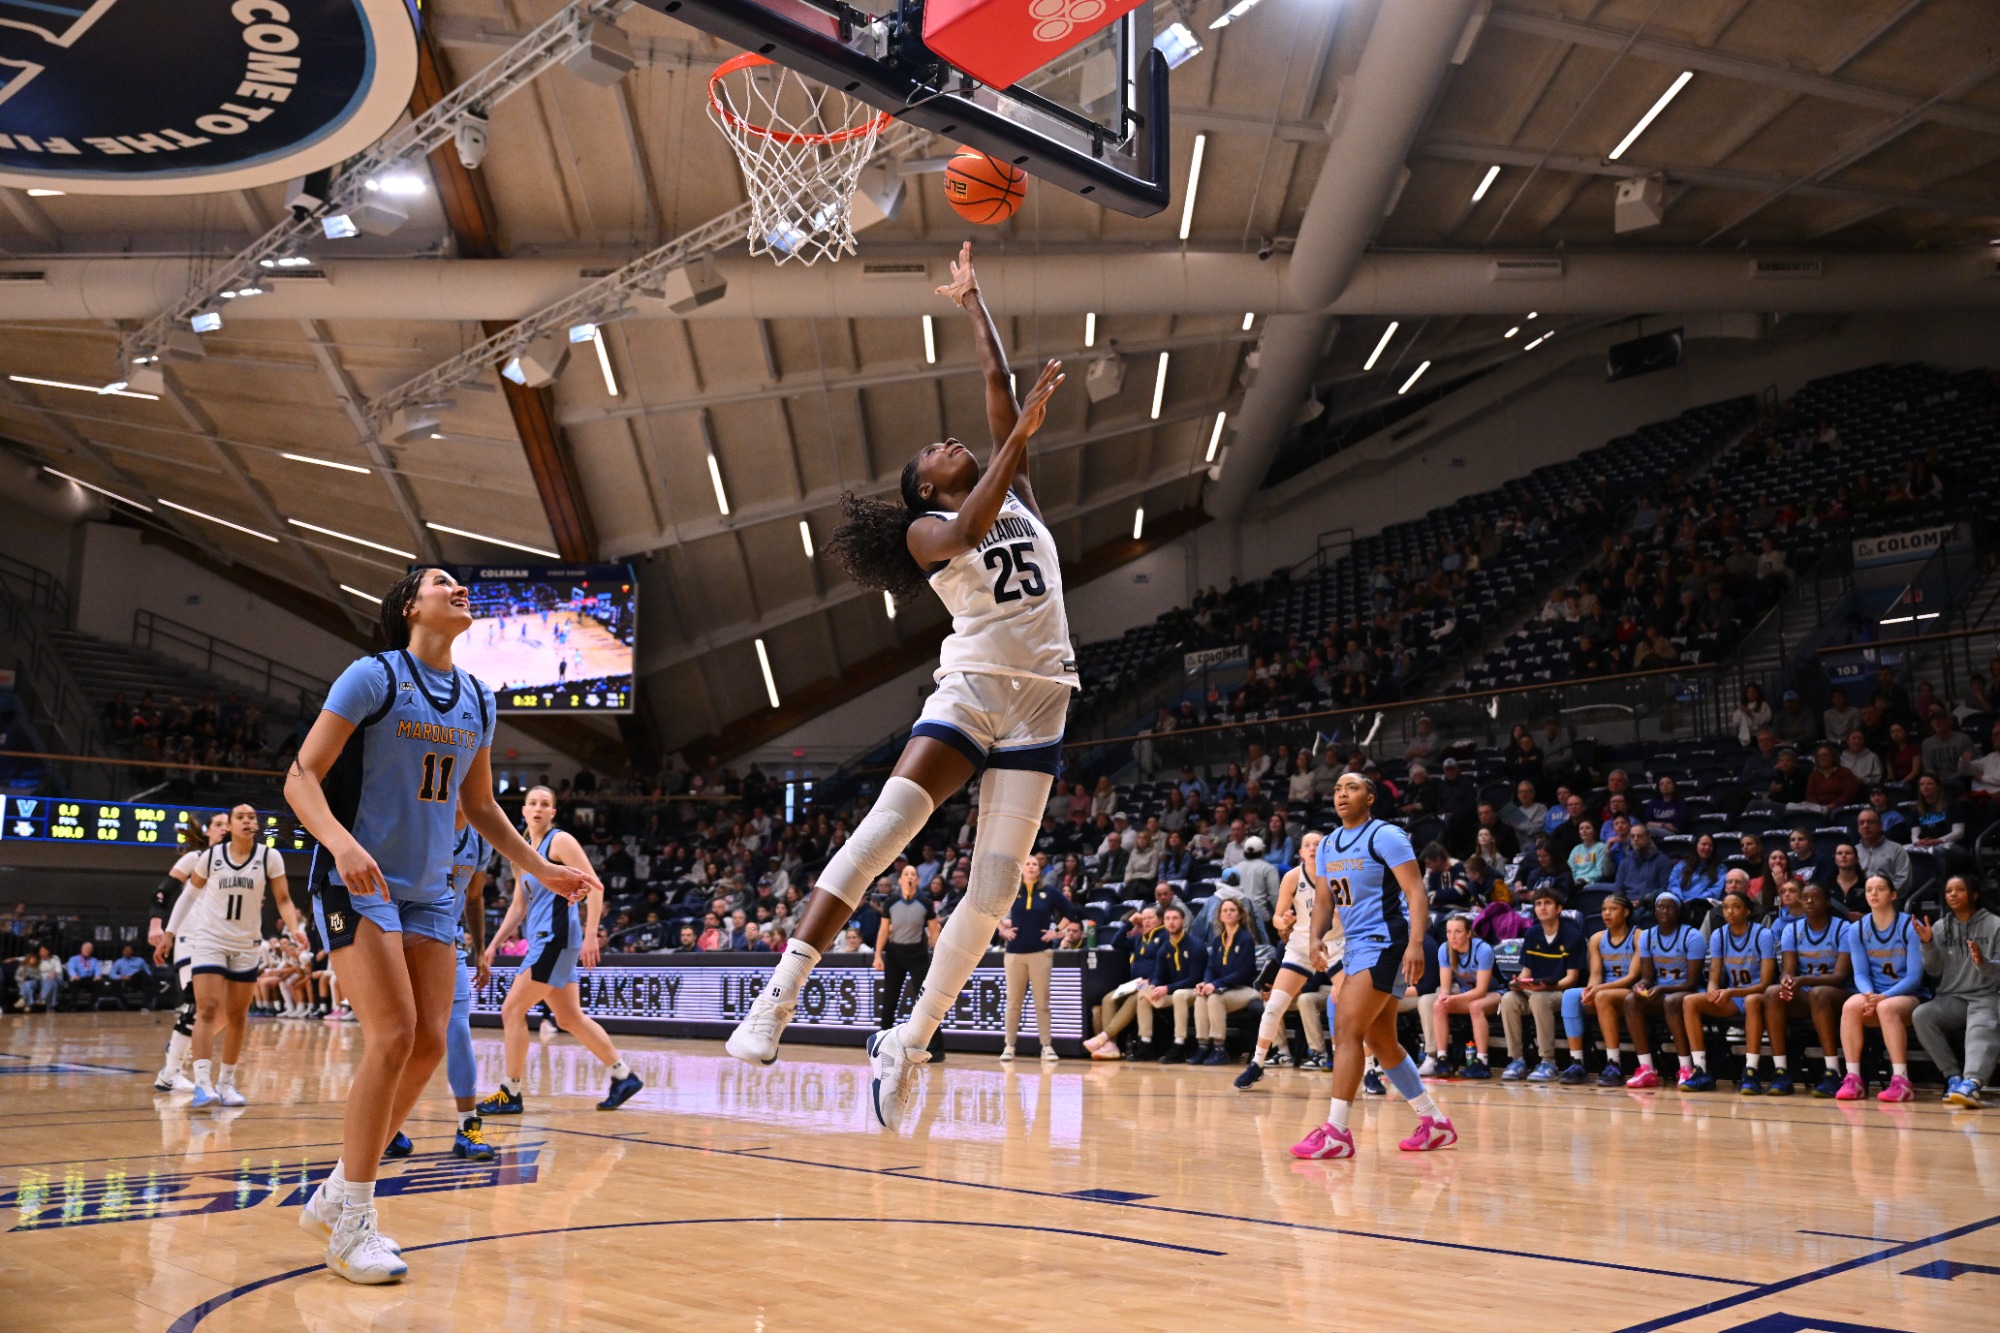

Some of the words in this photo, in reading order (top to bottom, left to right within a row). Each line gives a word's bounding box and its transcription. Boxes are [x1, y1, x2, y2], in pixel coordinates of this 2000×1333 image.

[231, 0, 302, 103] COME
[195, 102, 275, 136] TO
[83, 128, 212, 156] THE
[976, 517, 1039, 553] LLANOVA
[480, 569, 529, 578] COLEMAN
[983, 542, 1047, 604] 25
[1837, 665, 1859, 676] 103
[571, 695, 579, 707] 2
[397, 720, 477, 750] MARQUETTE
[418, 752, 455, 803] 11
[218, 876, 255, 890] VILLANOVA
[1330, 877, 1353, 907] 21
[226, 894, 243, 920] 11
[579, 974, 682, 1016] BAKERY
[722, 973, 857, 1020] LISO'S
